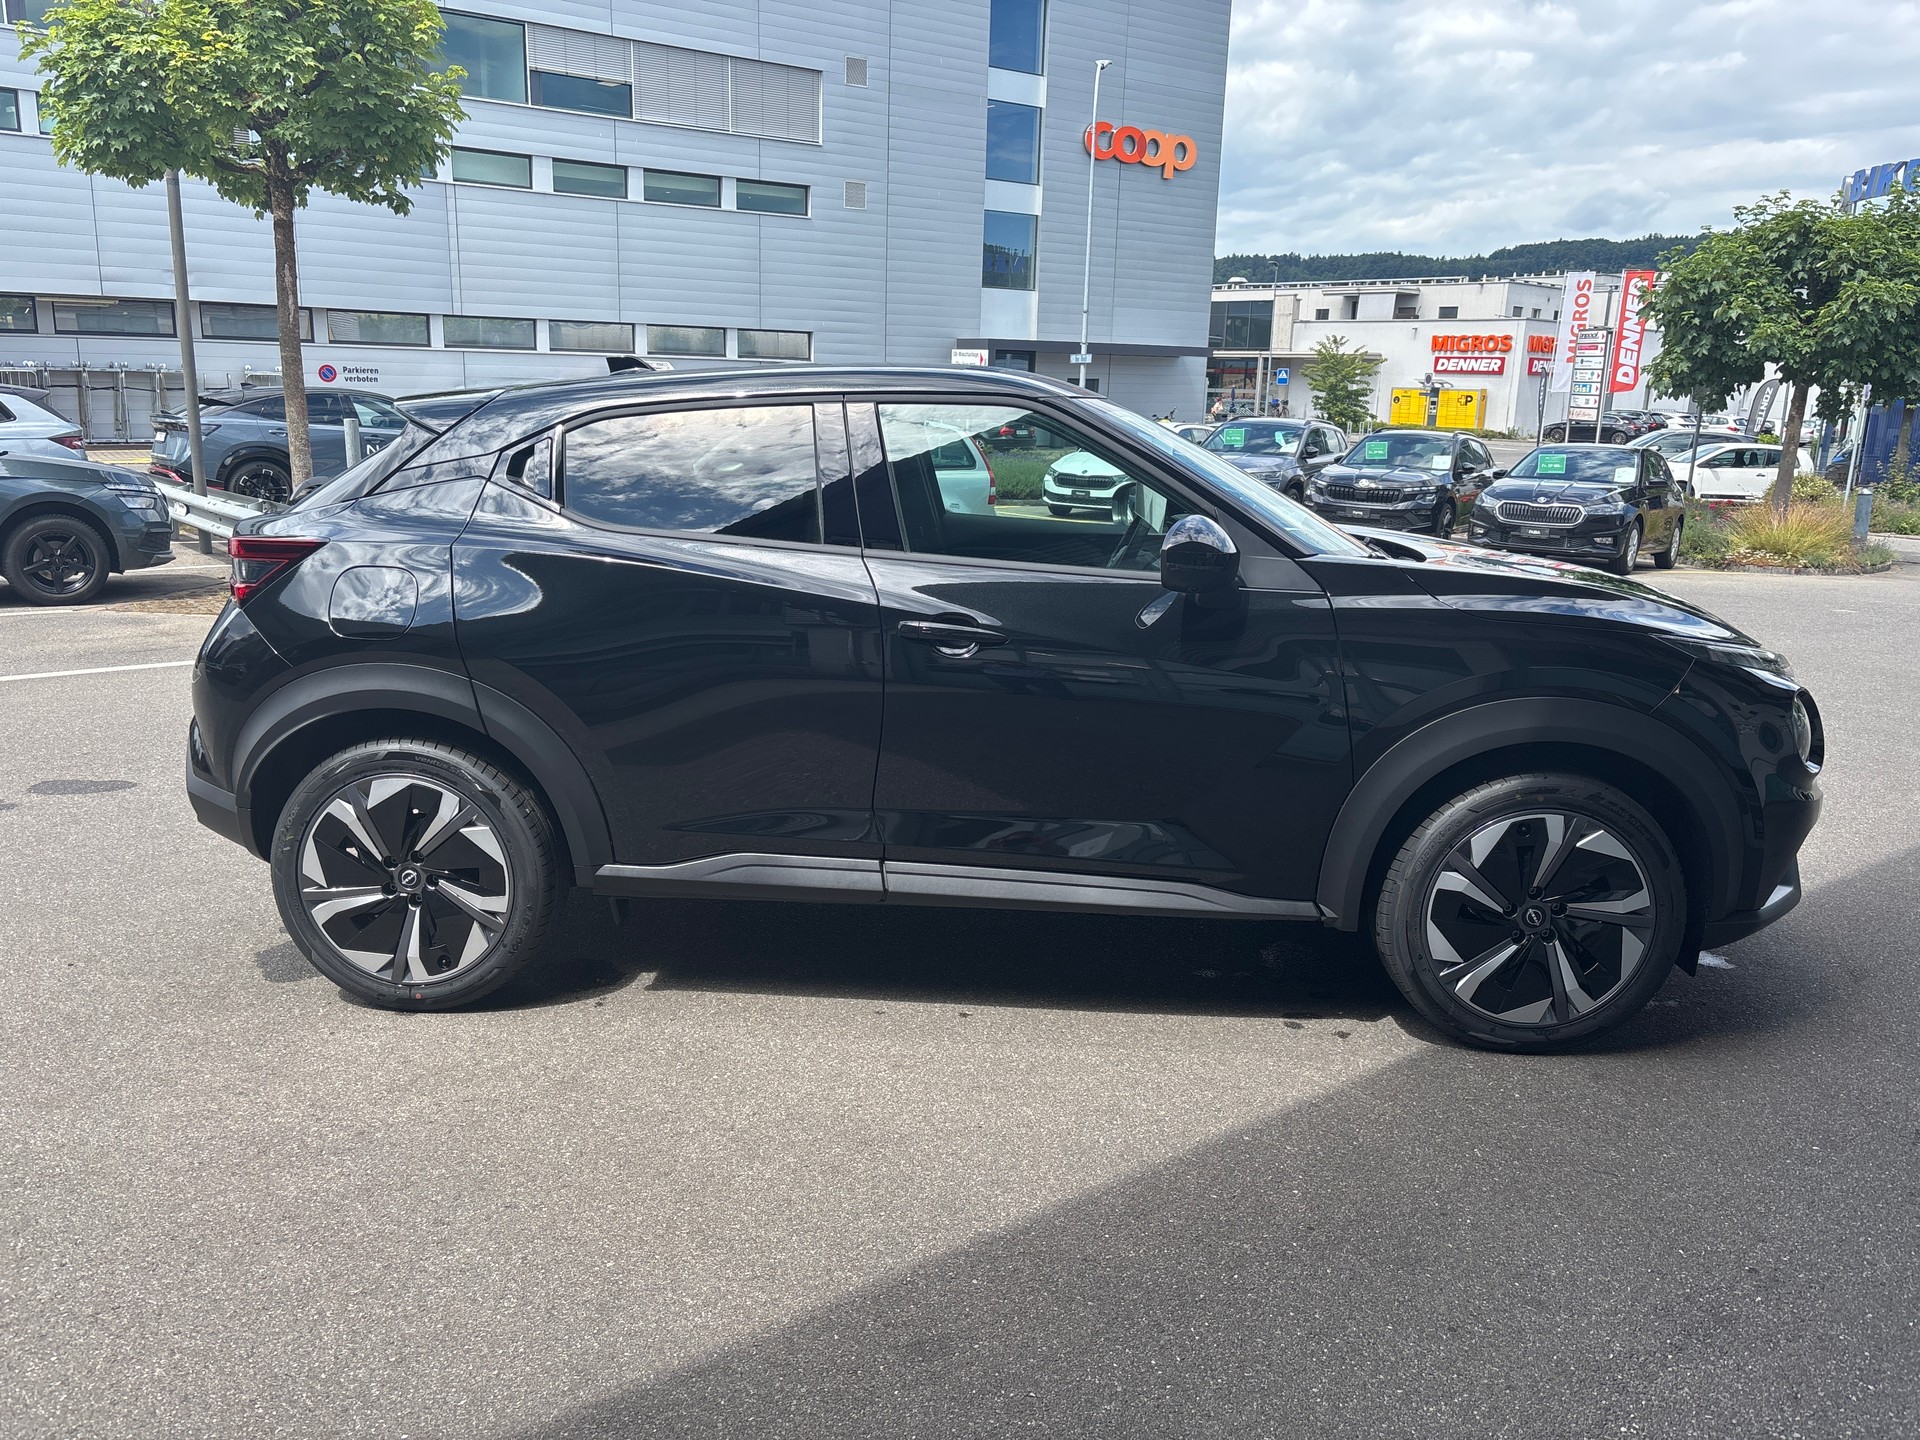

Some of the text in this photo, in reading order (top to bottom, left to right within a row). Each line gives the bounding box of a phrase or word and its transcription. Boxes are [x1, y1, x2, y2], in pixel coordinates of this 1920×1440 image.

[1085, 121, 1197, 179] coop
[1431, 334, 1512, 352] MIGROS
[342, 365, 379, 374] Parkieren
[1436, 358, 1502, 371] DENNER
[344, 375, 379, 383] verboten
[1754, 386, 1774, 432] ZONTES
